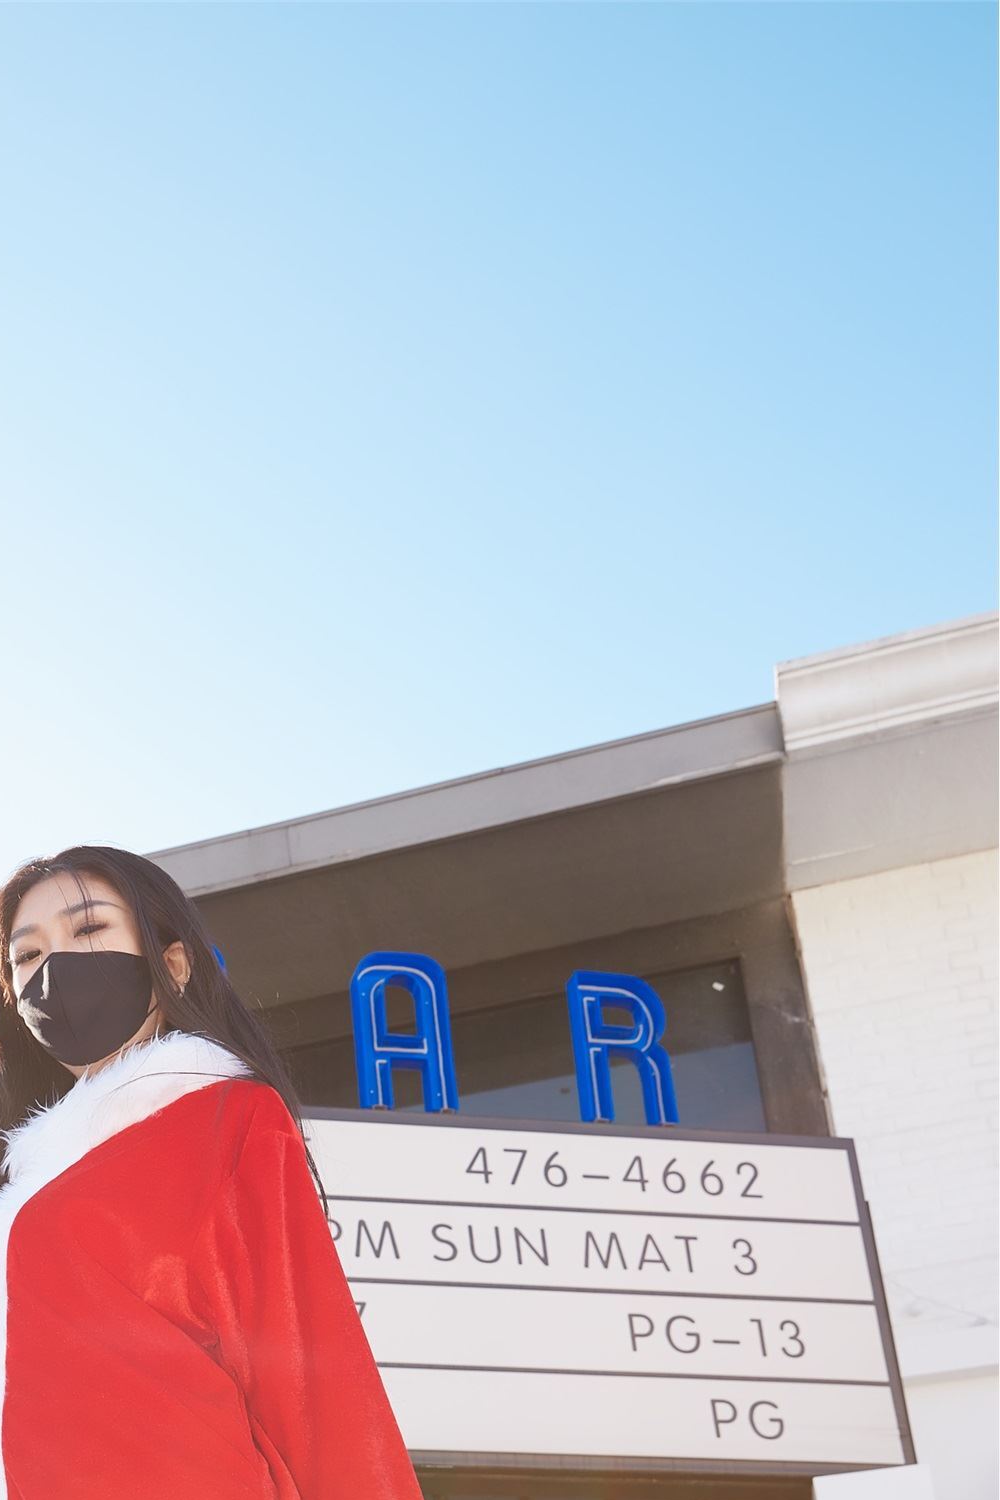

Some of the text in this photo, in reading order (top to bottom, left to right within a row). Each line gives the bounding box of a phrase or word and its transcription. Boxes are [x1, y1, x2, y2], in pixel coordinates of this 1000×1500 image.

[465, 1146, 764, 1198] 476-4662
[431, 1223, 550, 1266] SUN
[584, 1230, 699, 1274] MAT
[731, 1238, 758, 1275] 3
[626, 1313, 806, 1358] PG-13
[710, 1398, 785, 1440] PG
